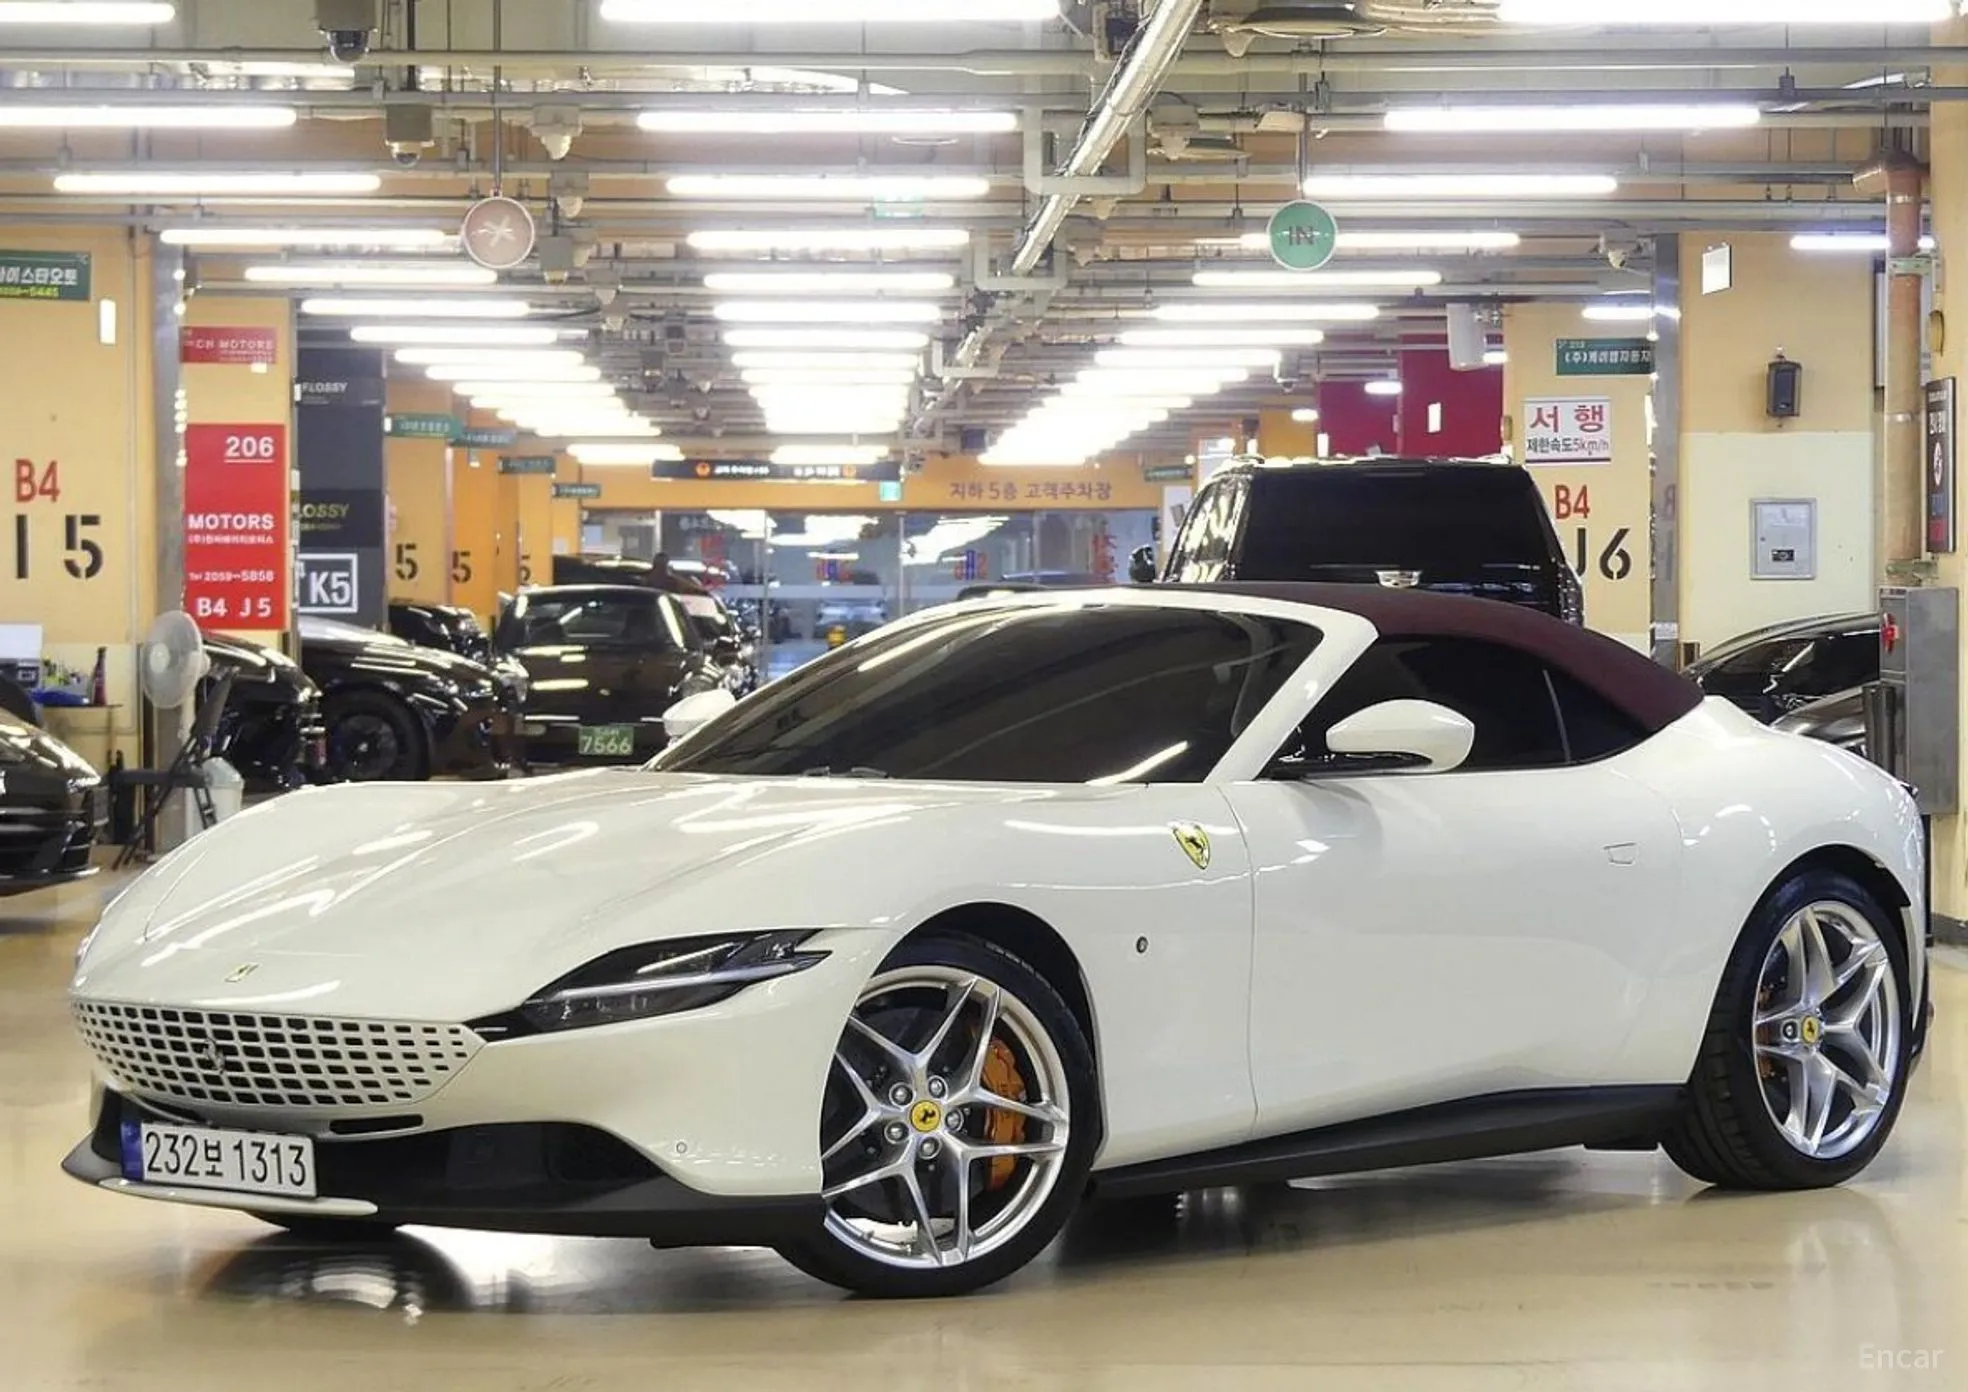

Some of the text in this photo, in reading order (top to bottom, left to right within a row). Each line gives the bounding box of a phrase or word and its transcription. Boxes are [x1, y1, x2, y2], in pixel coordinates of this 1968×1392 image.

[1289, 226, 1315, 245] IN
[225, 436, 274, 457] 206
[1527, 437, 1609, 453] 제한속도5km/h
[16, 458, 60, 502] B4
[1555, 485, 1590, 519] B4
[187, 514, 274, 529] MOTORS
[395, 543, 418, 580] 5
[452, 551, 471, 583] 5
[309, 570, 351, 604] K5
[197, 598, 228, 617] B4
[232, 1138, 306, 1187] 1313
